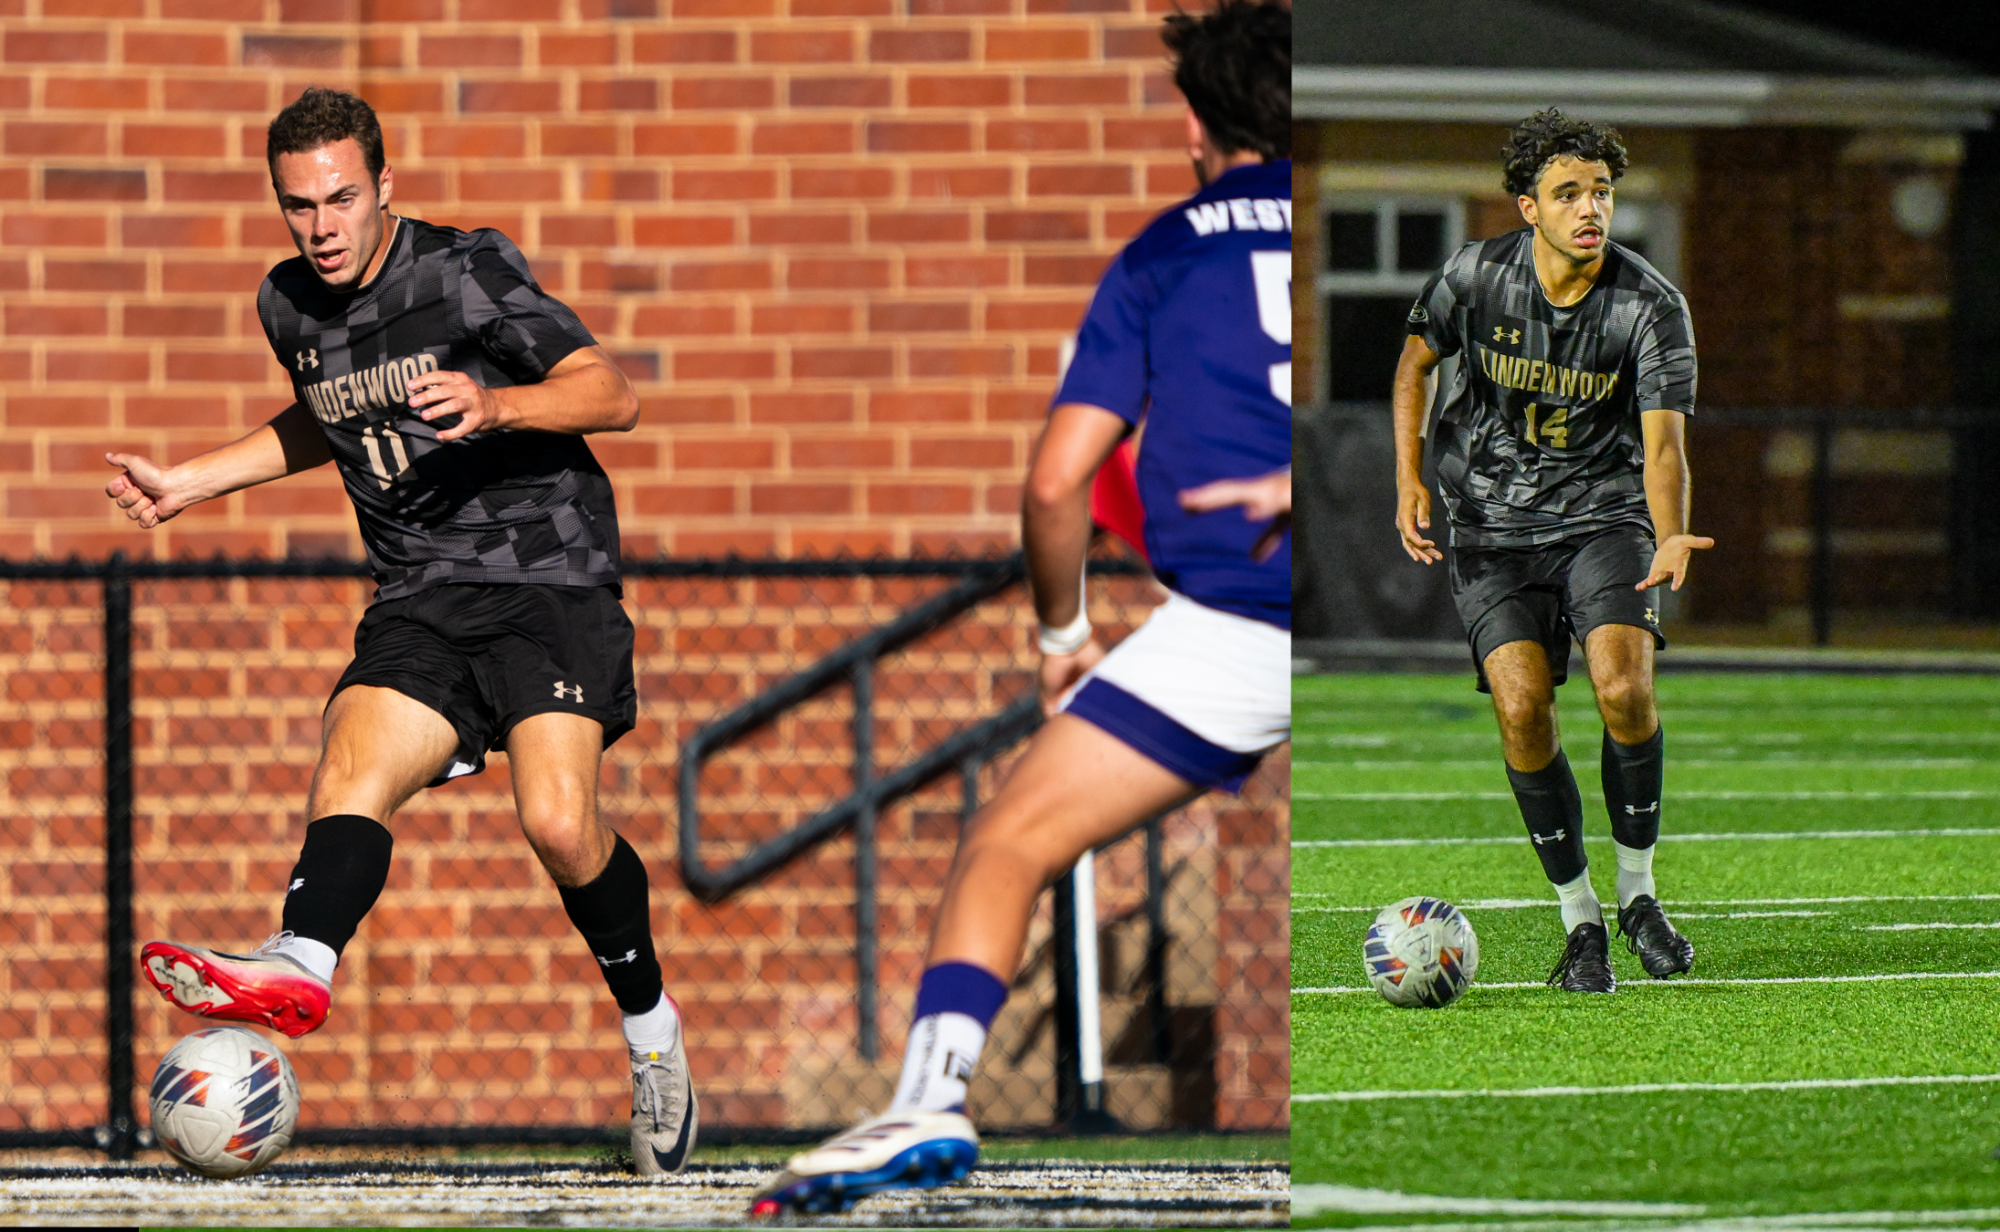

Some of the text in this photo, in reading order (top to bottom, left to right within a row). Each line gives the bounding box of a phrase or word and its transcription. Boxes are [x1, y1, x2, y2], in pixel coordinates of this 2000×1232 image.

[302, 353, 440, 425] INDENWOOD
[361, 421, 410, 491] 11
[1523, 402, 1568, 448] 14
